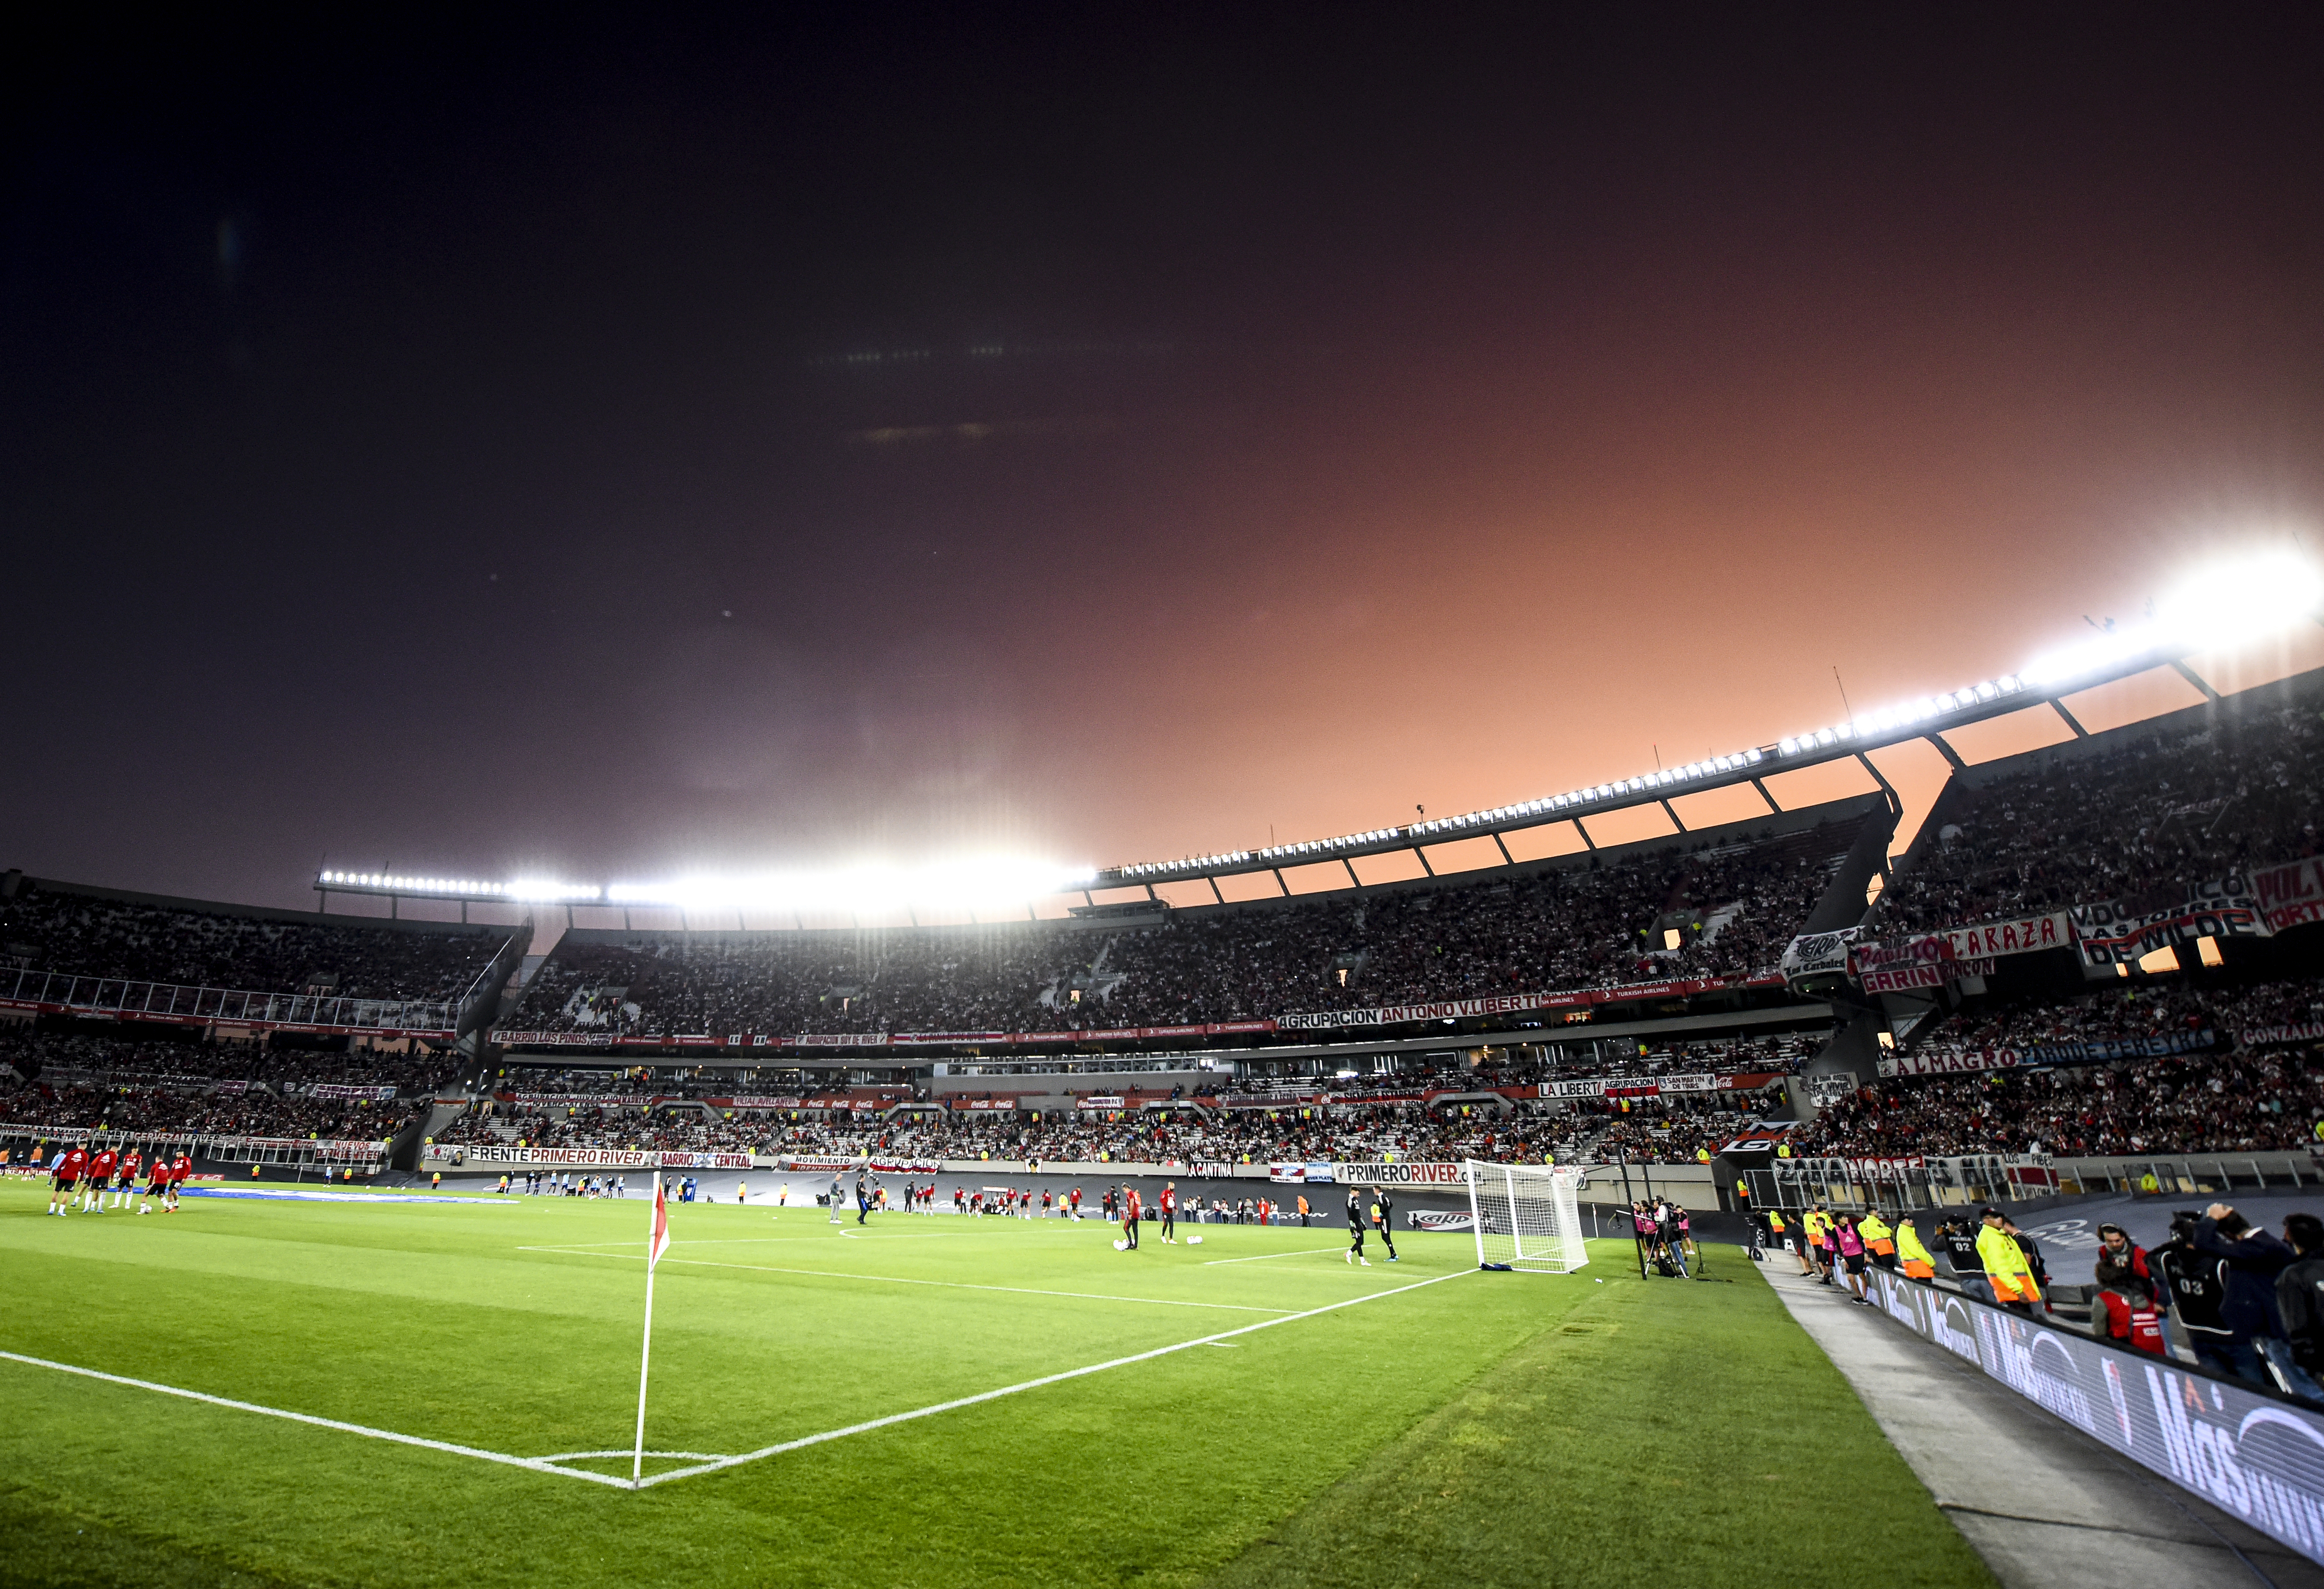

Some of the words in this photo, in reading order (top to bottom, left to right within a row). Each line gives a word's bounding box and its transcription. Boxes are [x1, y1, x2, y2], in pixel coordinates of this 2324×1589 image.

[2077, 924, 2129, 940] LAS
[2135, 898, 2254, 927] TORRES
[2139, 913, 2256, 952] WILDE
[1862, 966, 1940, 992] GARIN
[1550, 997, 1574, 1005] AIRLINES
[1279, 1010, 1378, 1028] AGRUPACION
[1382, 1002, 1455, 1022] ANTONIO
[500, 1032, 536, 1043] BARRIO
[538, 1032, 557, 1043] LOS
[559, 1033, 587, 1044] PINOS
[806, 1036, 838, 1044] AGRUPACION
[862, 1035, 877, 1044] RIVER
[1897, 1048, 2016, 1075] ALMAGRO
[2243, 1020, 2324, 1045] GONZALO
[1605, 1077, 1654, 1088] AGRUPACION
[1344, 1092, 1379, 1100] SIEMPRE
[1540, 1083, 1556, 1097] LA
[737, 1097, 755, 1105] FILIAL
[192, 1134, 220, 1142] RIVER
[335, 1141, 370, 1151] NUEVOS
[470, 1146, 529, 1161] FRENTE
[531, 1149, 597, 1163] PRIMERO
[600, 1150, 643, 1164] RIVER
[661, 1152, 693, 1166] BARRIO
[715, 1154, 752, 1168] CENTRAL
[796, 1156, 850, 1164] MOVIMIENTO
[2005, 1154, 2019, 1164] LOS
[2032, 1154, 2053, 1166] PIBES
[872, 1158, 942, 1168] AGRUPACION
[1186, 1163, 1197, 1178] LA
[1197, 1163, 1232, 1178] CANTINA
[1347, 1164, 1482, 1183] PRIMERORIVER.CM
[1850, 1158, 1921, 1185] NORTE
[1955, 1242, 1971, 1252] 02
[2179, 1277, 2204, 1296] 03
